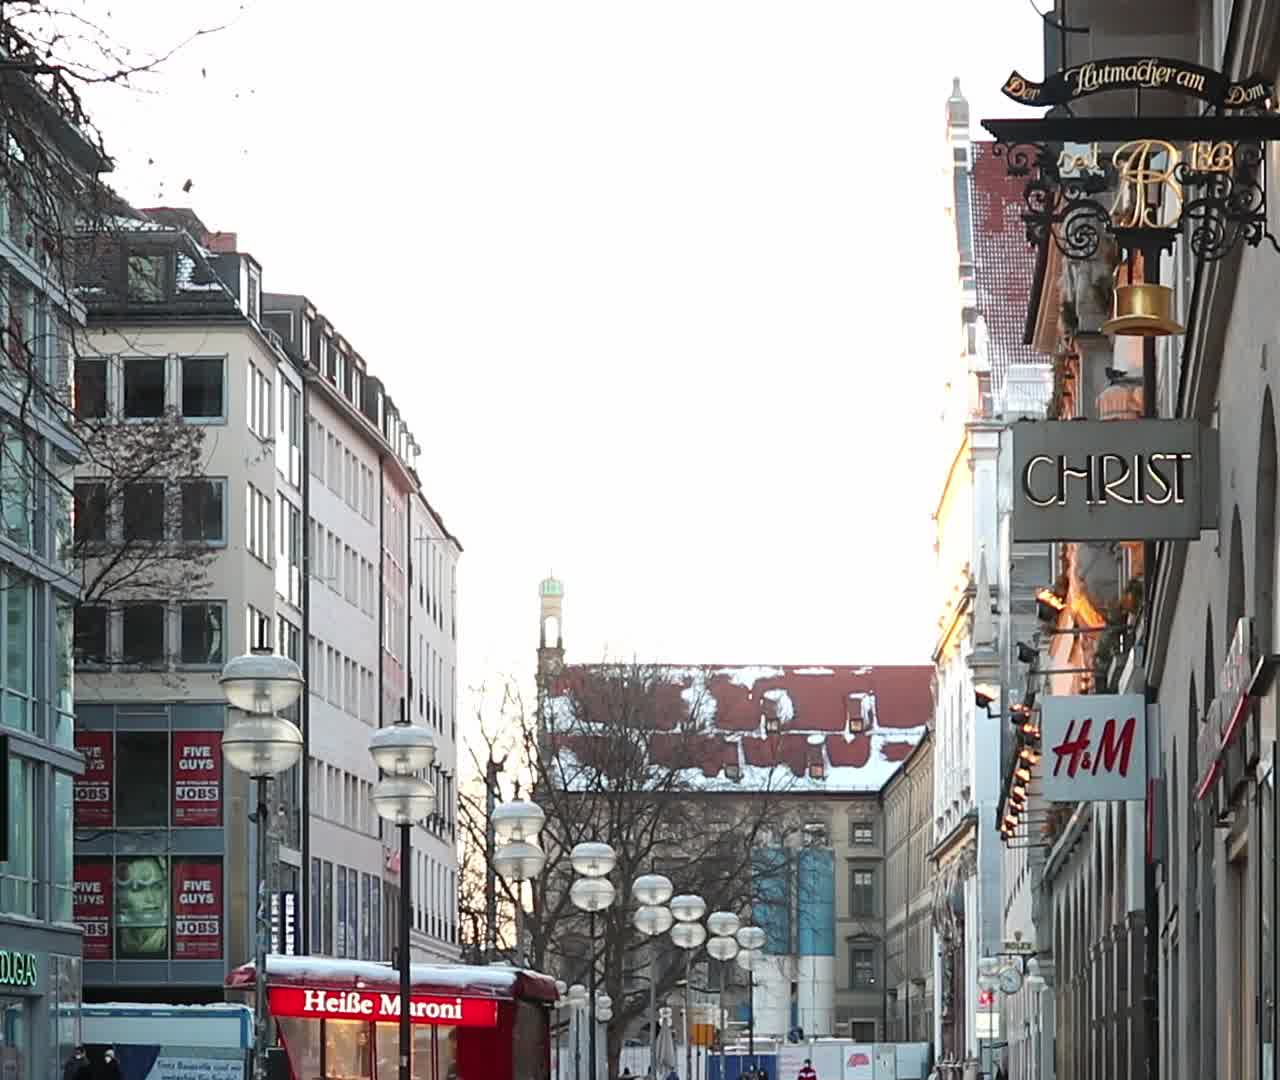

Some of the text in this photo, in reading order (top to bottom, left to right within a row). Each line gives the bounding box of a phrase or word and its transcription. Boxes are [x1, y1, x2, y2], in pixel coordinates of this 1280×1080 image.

[1065, 59, 1176, 96] Hutmacher
[1177, 71, 1205, 92] am
[1225, 83, 1265, 105] Dom
[1023, 453, 1192, 506] CHRIST
[183, 746, 211, 758] FIVE
[1052, 717, 1136, 778] H&M
[179, 759, 214, 770] GUYS
[75, 788, 107, 800] OBS
[177, 788, 217, 800] JOBS
[73, 882, 101, 893] FIVE
[183, 880, 211, 892] FIVE
[179, 893, 214, 905] GUYS
[177, 922, 217, 934] JOBS
[286, 894, 294, 955] RETTER
[304, 990, 372, 1014] Heiße
